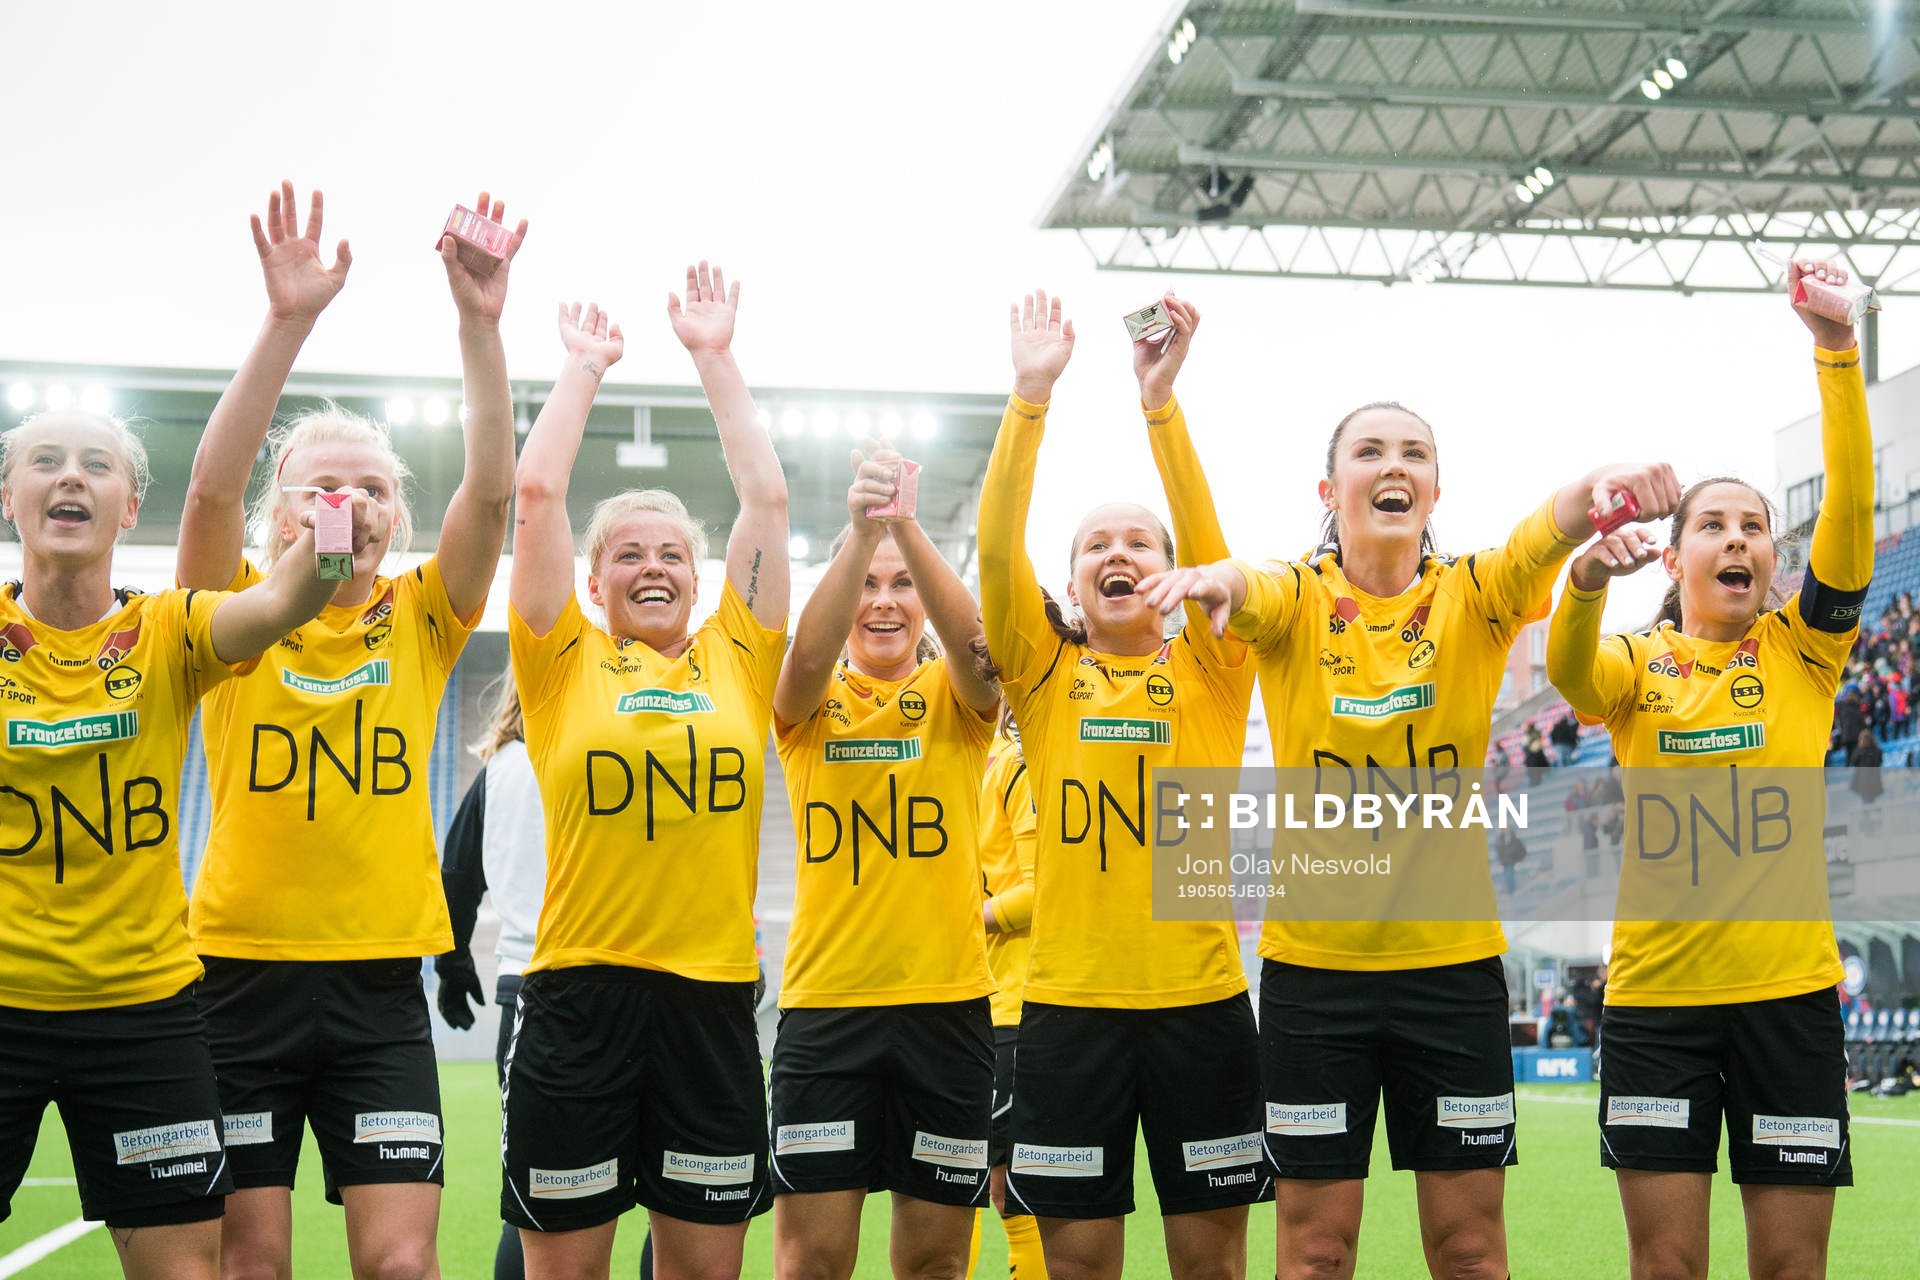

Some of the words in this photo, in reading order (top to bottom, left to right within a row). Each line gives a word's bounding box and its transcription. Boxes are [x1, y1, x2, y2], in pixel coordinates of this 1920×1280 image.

[280, 637, 304, 653] SPORT
[1695, 659, 1722, 677] humm
[109, 676, 140, 691] LSK
[288, 669, 370, 693] Franzefoss
[1149, 685, 1170, 694] LSK
[7, 689, 37, 705] SPORT
[1734, 686, 1760, 697] LSK
[901, 700, 924, 711] LSK
[1340, 692, 1418, 716] Franzefoss
[1653, 705, 1674, 714] SPORT
[831, 711, 851, 728] SPORT
[16, 721, 112, 744] Franzefoss
[1083, 721, 1150, 739] Franzefoss
[1664, 731, 1741, 751] Franzefoss
[829, 742, 899, 759] Franzefoss
[249, 699, 412, 821] DNB
[586, 724, 746, 841] DNB
[1313, 724, 1461, 842] DNB
[0, 753, 169, 884] DNB
[1061, 754, 1188, 872] DNB
[806, 774, 948, 886] DNB
[1637, 763, 1792, 887] DNB
[1270, 1106, 1337, 1123] Betongarbeid
[1443, 1099, 1509, 1114] Betongarbeid
[1611, 1099, 1680, 1113] Betongarbeid
[223, 1115, 263, 1131] arbeid
[361, 1115, 435, 1129] Betongarbeid
[1759, 1118, 1833, 1135] Betongarbeid
[121, 1124, 210, 1148] Betongarbeid
[779, 1125, 847, 1142] Betongarbeid
[1461, 1129, 1505, 1146] hummel
[379, 1143, 430, 1160] hummel
[920, 1135, 984, 1156] Betongarbeid
[1189, 1135, 1262, 1157] Betongarbeid
[670, 1154, 748, 1174] Betongarbeid
[1018, 1147, 1093, 1165] Betongarbeid
[1779, 1148, 1828, 1165] hummel
[149, 1156, 208, 1180] hummel
[535, 1165, 611, 1187] Betongarbeid
[935, 1166, 979, 1185] hummel
[1208, 1168, 1257, 1188] hummel
[705, 1186, 750, 1202] hummel
